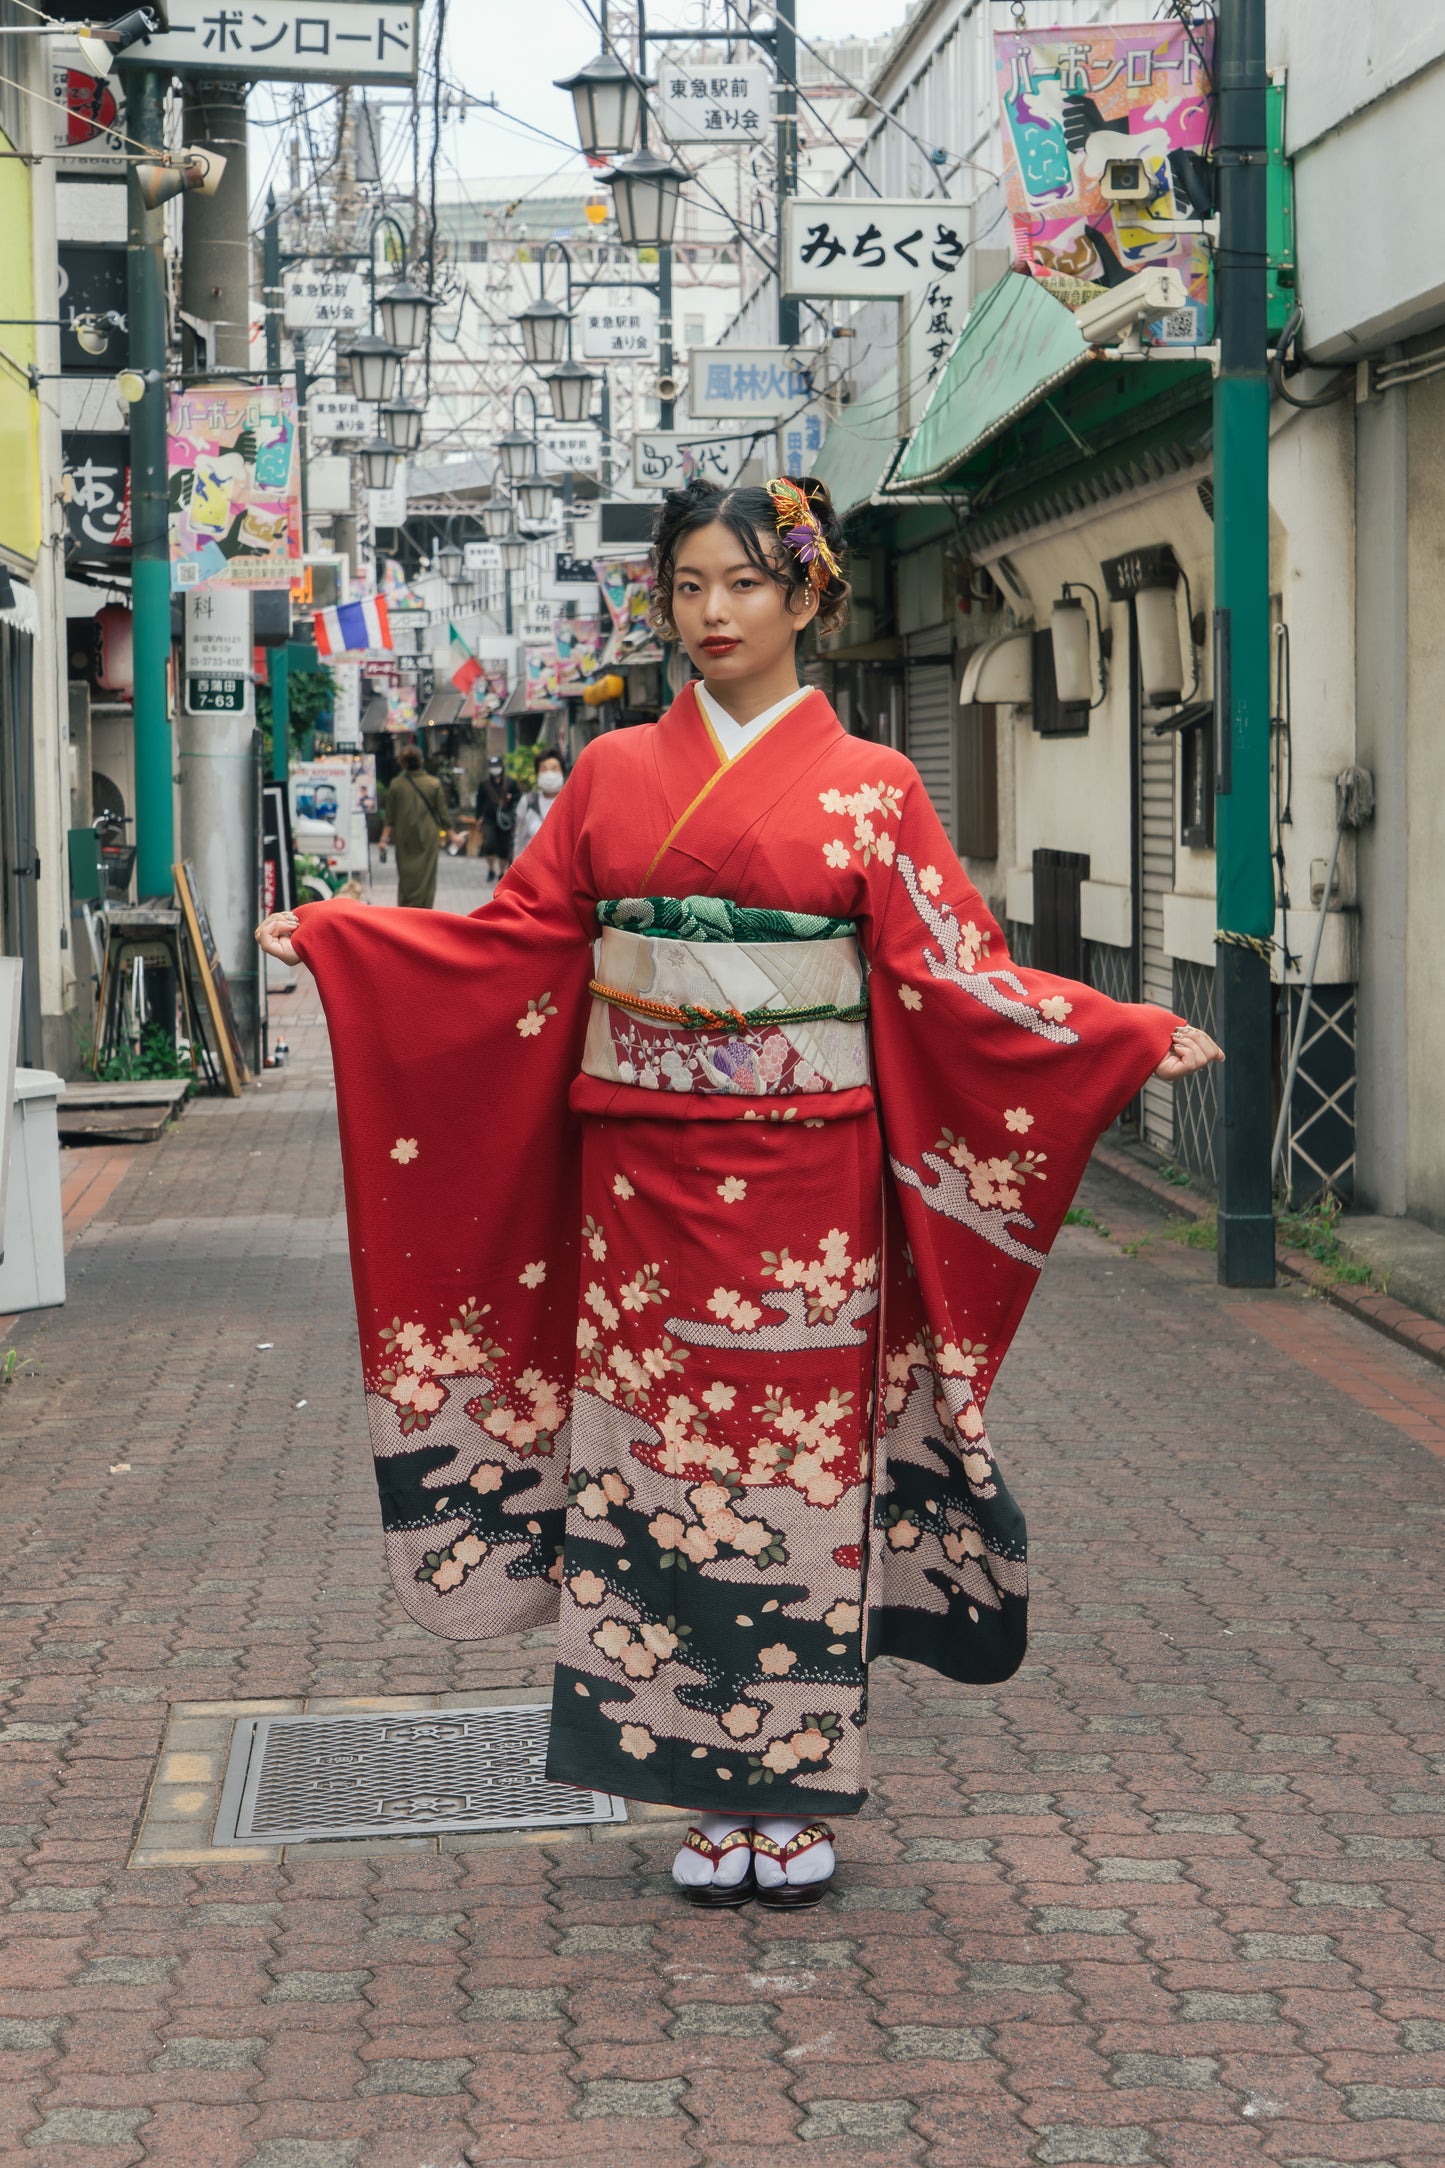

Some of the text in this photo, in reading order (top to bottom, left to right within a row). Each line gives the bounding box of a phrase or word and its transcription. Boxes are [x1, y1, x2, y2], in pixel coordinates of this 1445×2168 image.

[142, 10, 410, 60] ーボンロード
[1007, 37, 1206, 104] バーボンロード
[669, 78, 749, 98] 東急駅前
[704, 108, 760, 130] 通り会
[800, 222, 964, 273] みちくさ
[291, 283, 348, 298] 東急駅前
[315, 305, 355, 320] 通り会
[588, 314, 641, 329] 東急駅前
[611, 336, 647, 350] 通り会
[704, 363, 812, 401] 風林火山
[176, 396, 291, 435] バーボンロード
[193, 597, 214, 619] 科
[199, 695, 235, 708] 7-63
